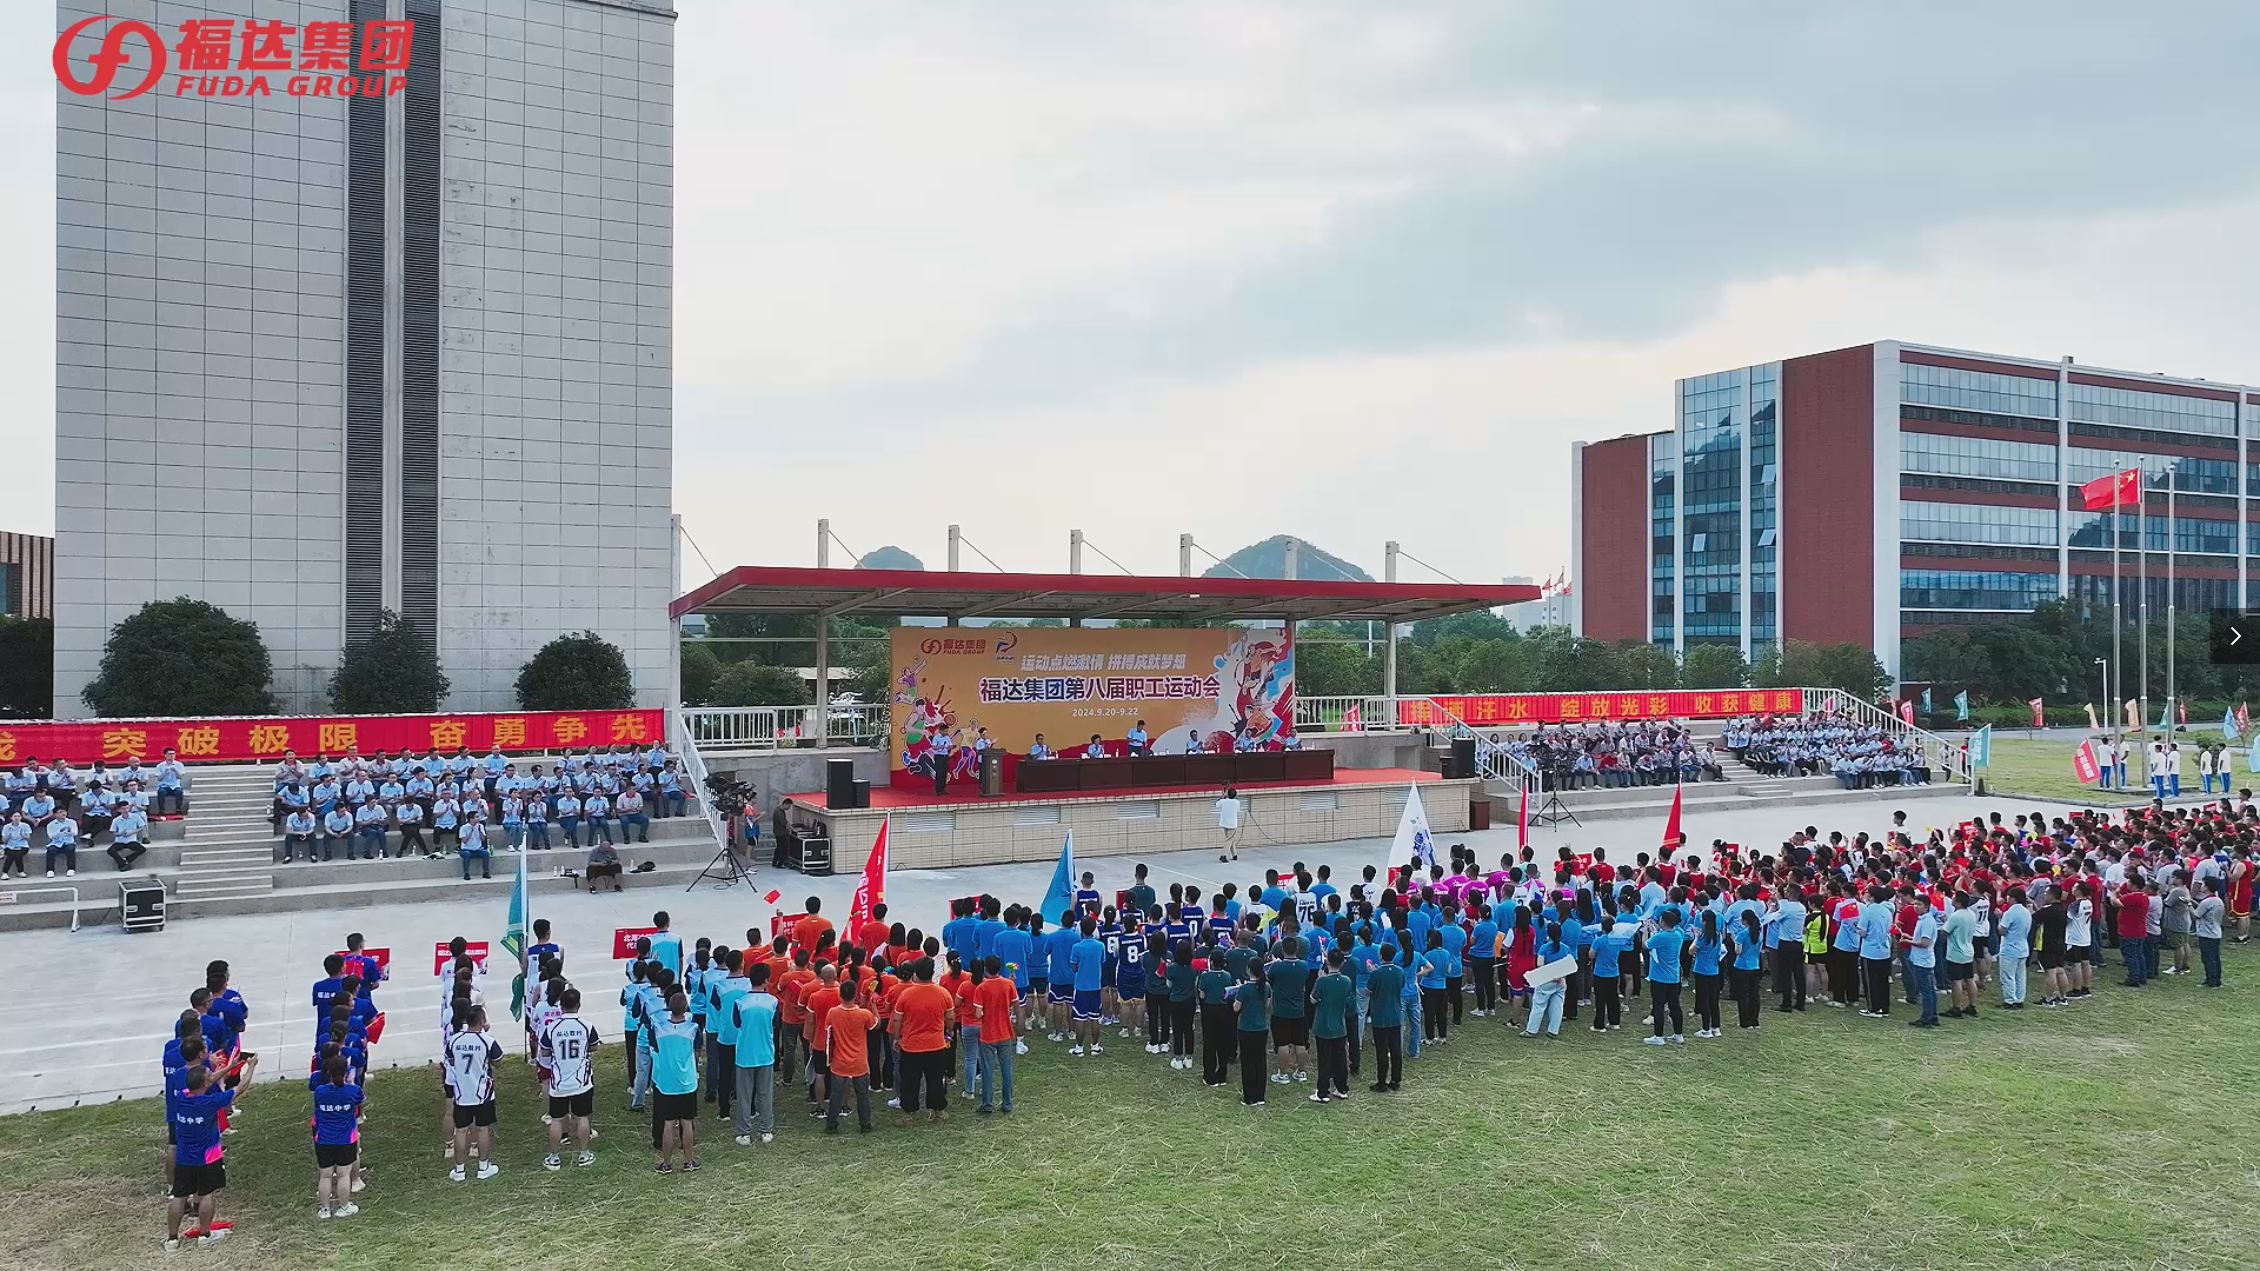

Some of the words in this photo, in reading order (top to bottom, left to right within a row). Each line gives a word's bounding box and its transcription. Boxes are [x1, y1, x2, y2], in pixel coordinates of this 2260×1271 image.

[1020, 654, 1104, 671] 运动点燃激情
[1107, 653, 1187, 670] 拼搏成就梦想
[979, 675, 1221, 702] 福达集团第八届职工运动会
[1072, 707, 1139, 717] 2024.9.20-9.22
[1560, 696, 1668, 718] 绽放光彩
[1695, 692, 1793, 713] 收获健康
[102, 723, 358, 758] 突破极限
[429, 713, 646, 747] 奋勇争先
[1127, 945, 1138, 963] 8
[558, 1039, 580, 1060] 16
[461, 1053, 474, 1075] 7
